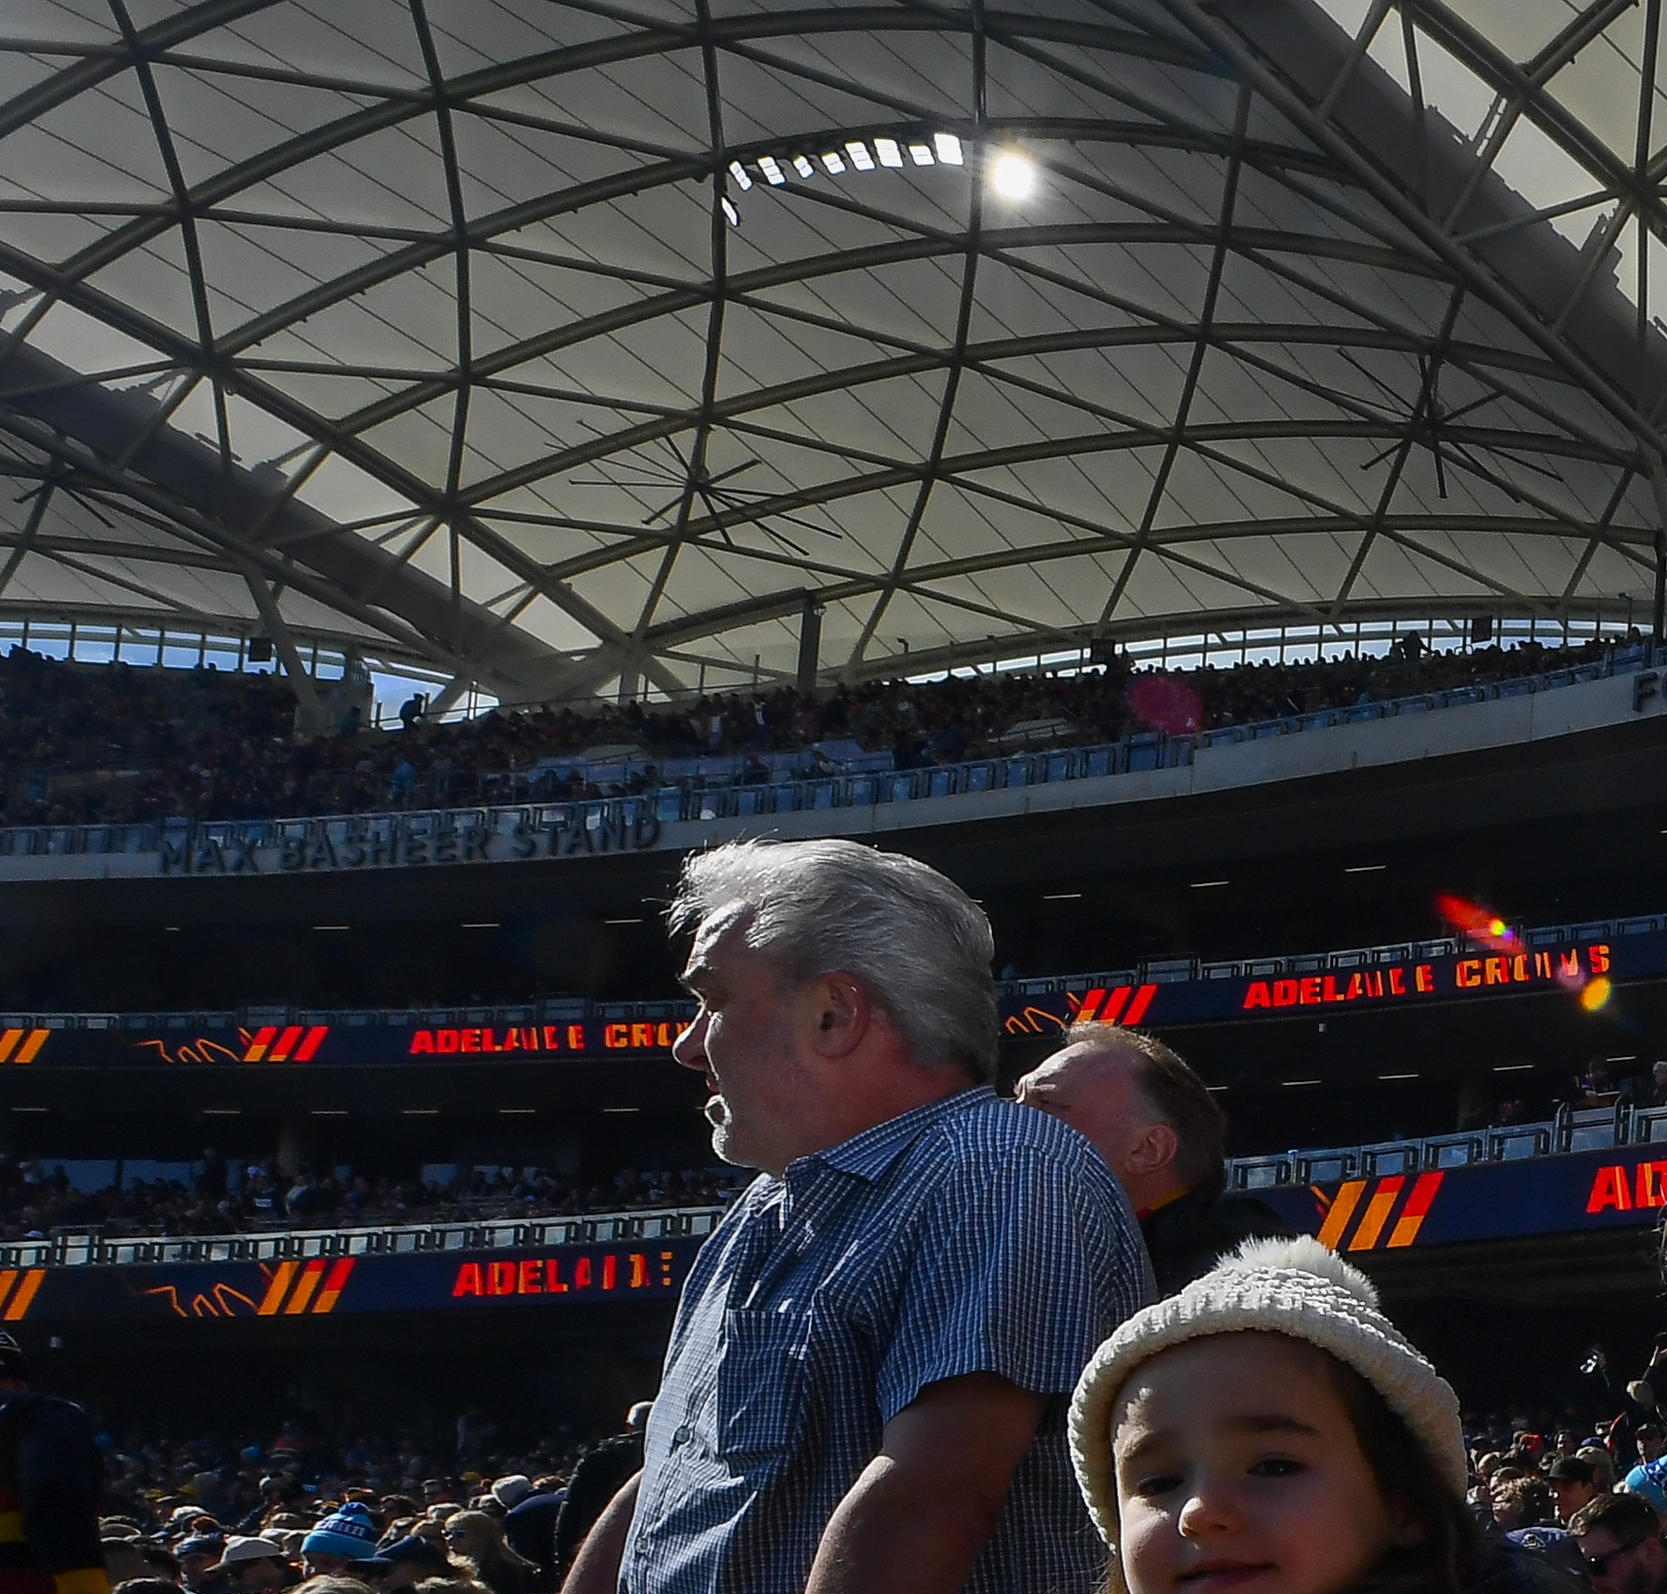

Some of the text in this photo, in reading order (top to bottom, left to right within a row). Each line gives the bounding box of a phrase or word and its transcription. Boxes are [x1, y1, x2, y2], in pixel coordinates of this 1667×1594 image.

[160, 813, 661, 874] MAX BASHEER STAND
